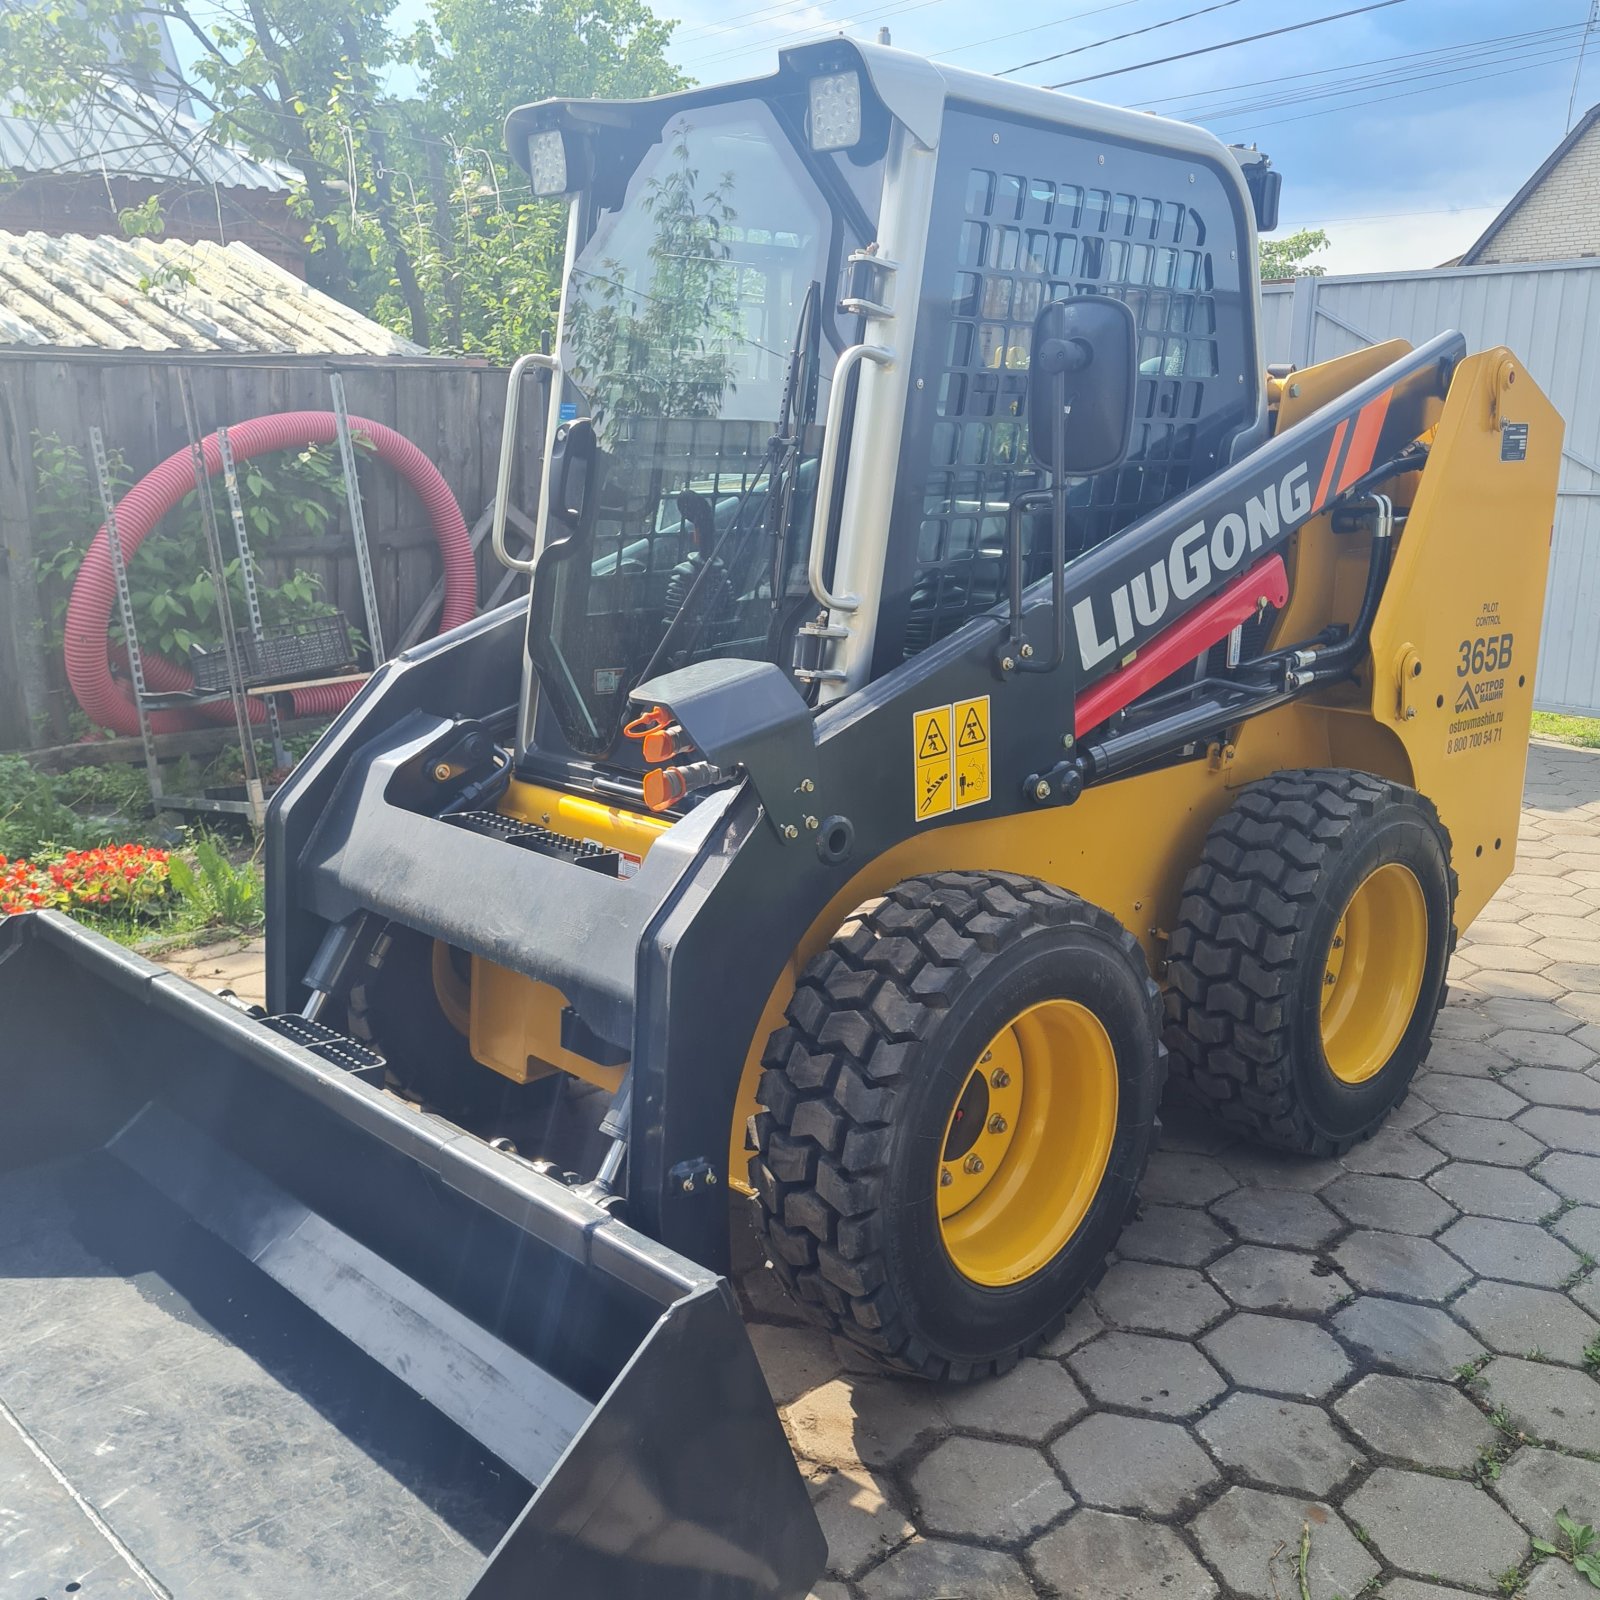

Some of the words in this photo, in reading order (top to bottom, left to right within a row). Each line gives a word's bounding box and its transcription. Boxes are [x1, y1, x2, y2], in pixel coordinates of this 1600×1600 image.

[1072, 461, 1311, 671] LIUGONG
[1482, 602, 1499, 613] PILOT
[1475, 615, 1501, 627] CONTROL
[1456, 633, 1514, 678] 365B
[1474, 678, 1505, 694] ОСТРОВ
[1479, 690, 1504, 703] МАШИН
[1449, 711, 1504, 735] ostrovmashin.ru
[1447, 739, 1453, 755] 8
[1453, 735, 1468, 753] 800
[1469, 731, 1483, 749] 700
[1483, 729, 1493, 745] 54
[1493, 727, 1502, 743] 71
